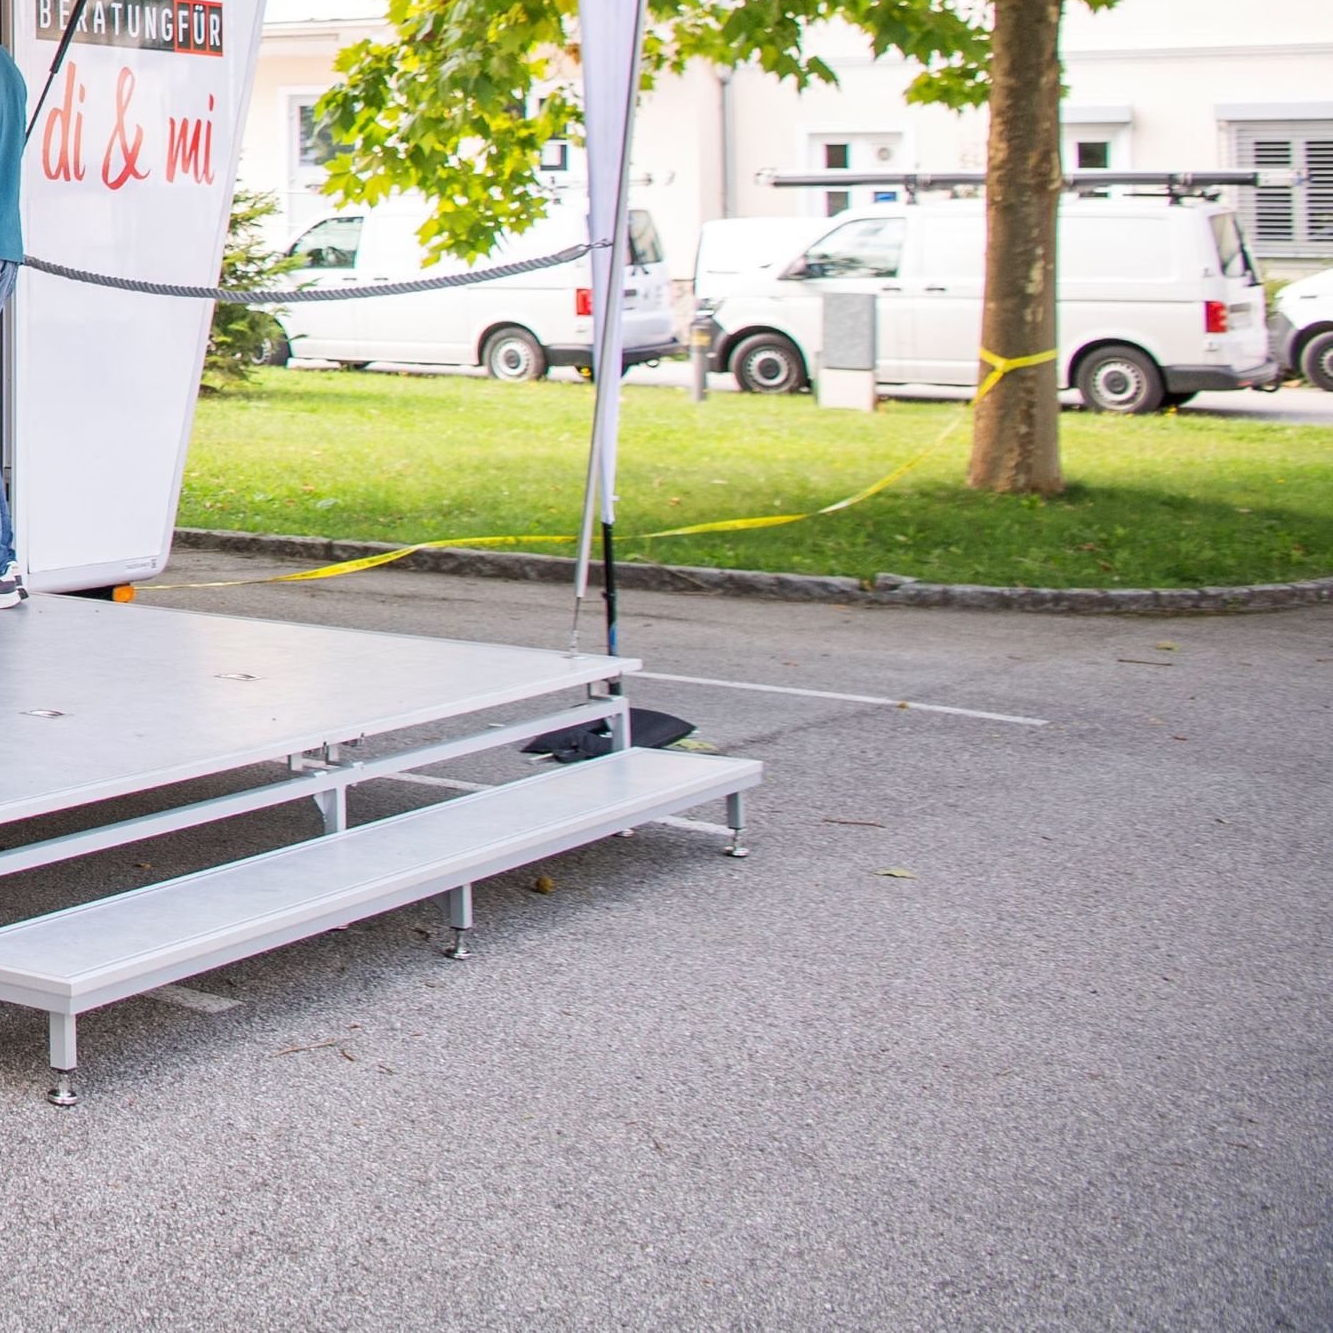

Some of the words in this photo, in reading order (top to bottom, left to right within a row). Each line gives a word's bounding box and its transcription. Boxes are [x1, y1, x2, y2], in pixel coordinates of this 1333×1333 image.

[42, 60, 86, 182] di
[101, 66, 151, 191] &
[165, 93, 215, 185] mi
